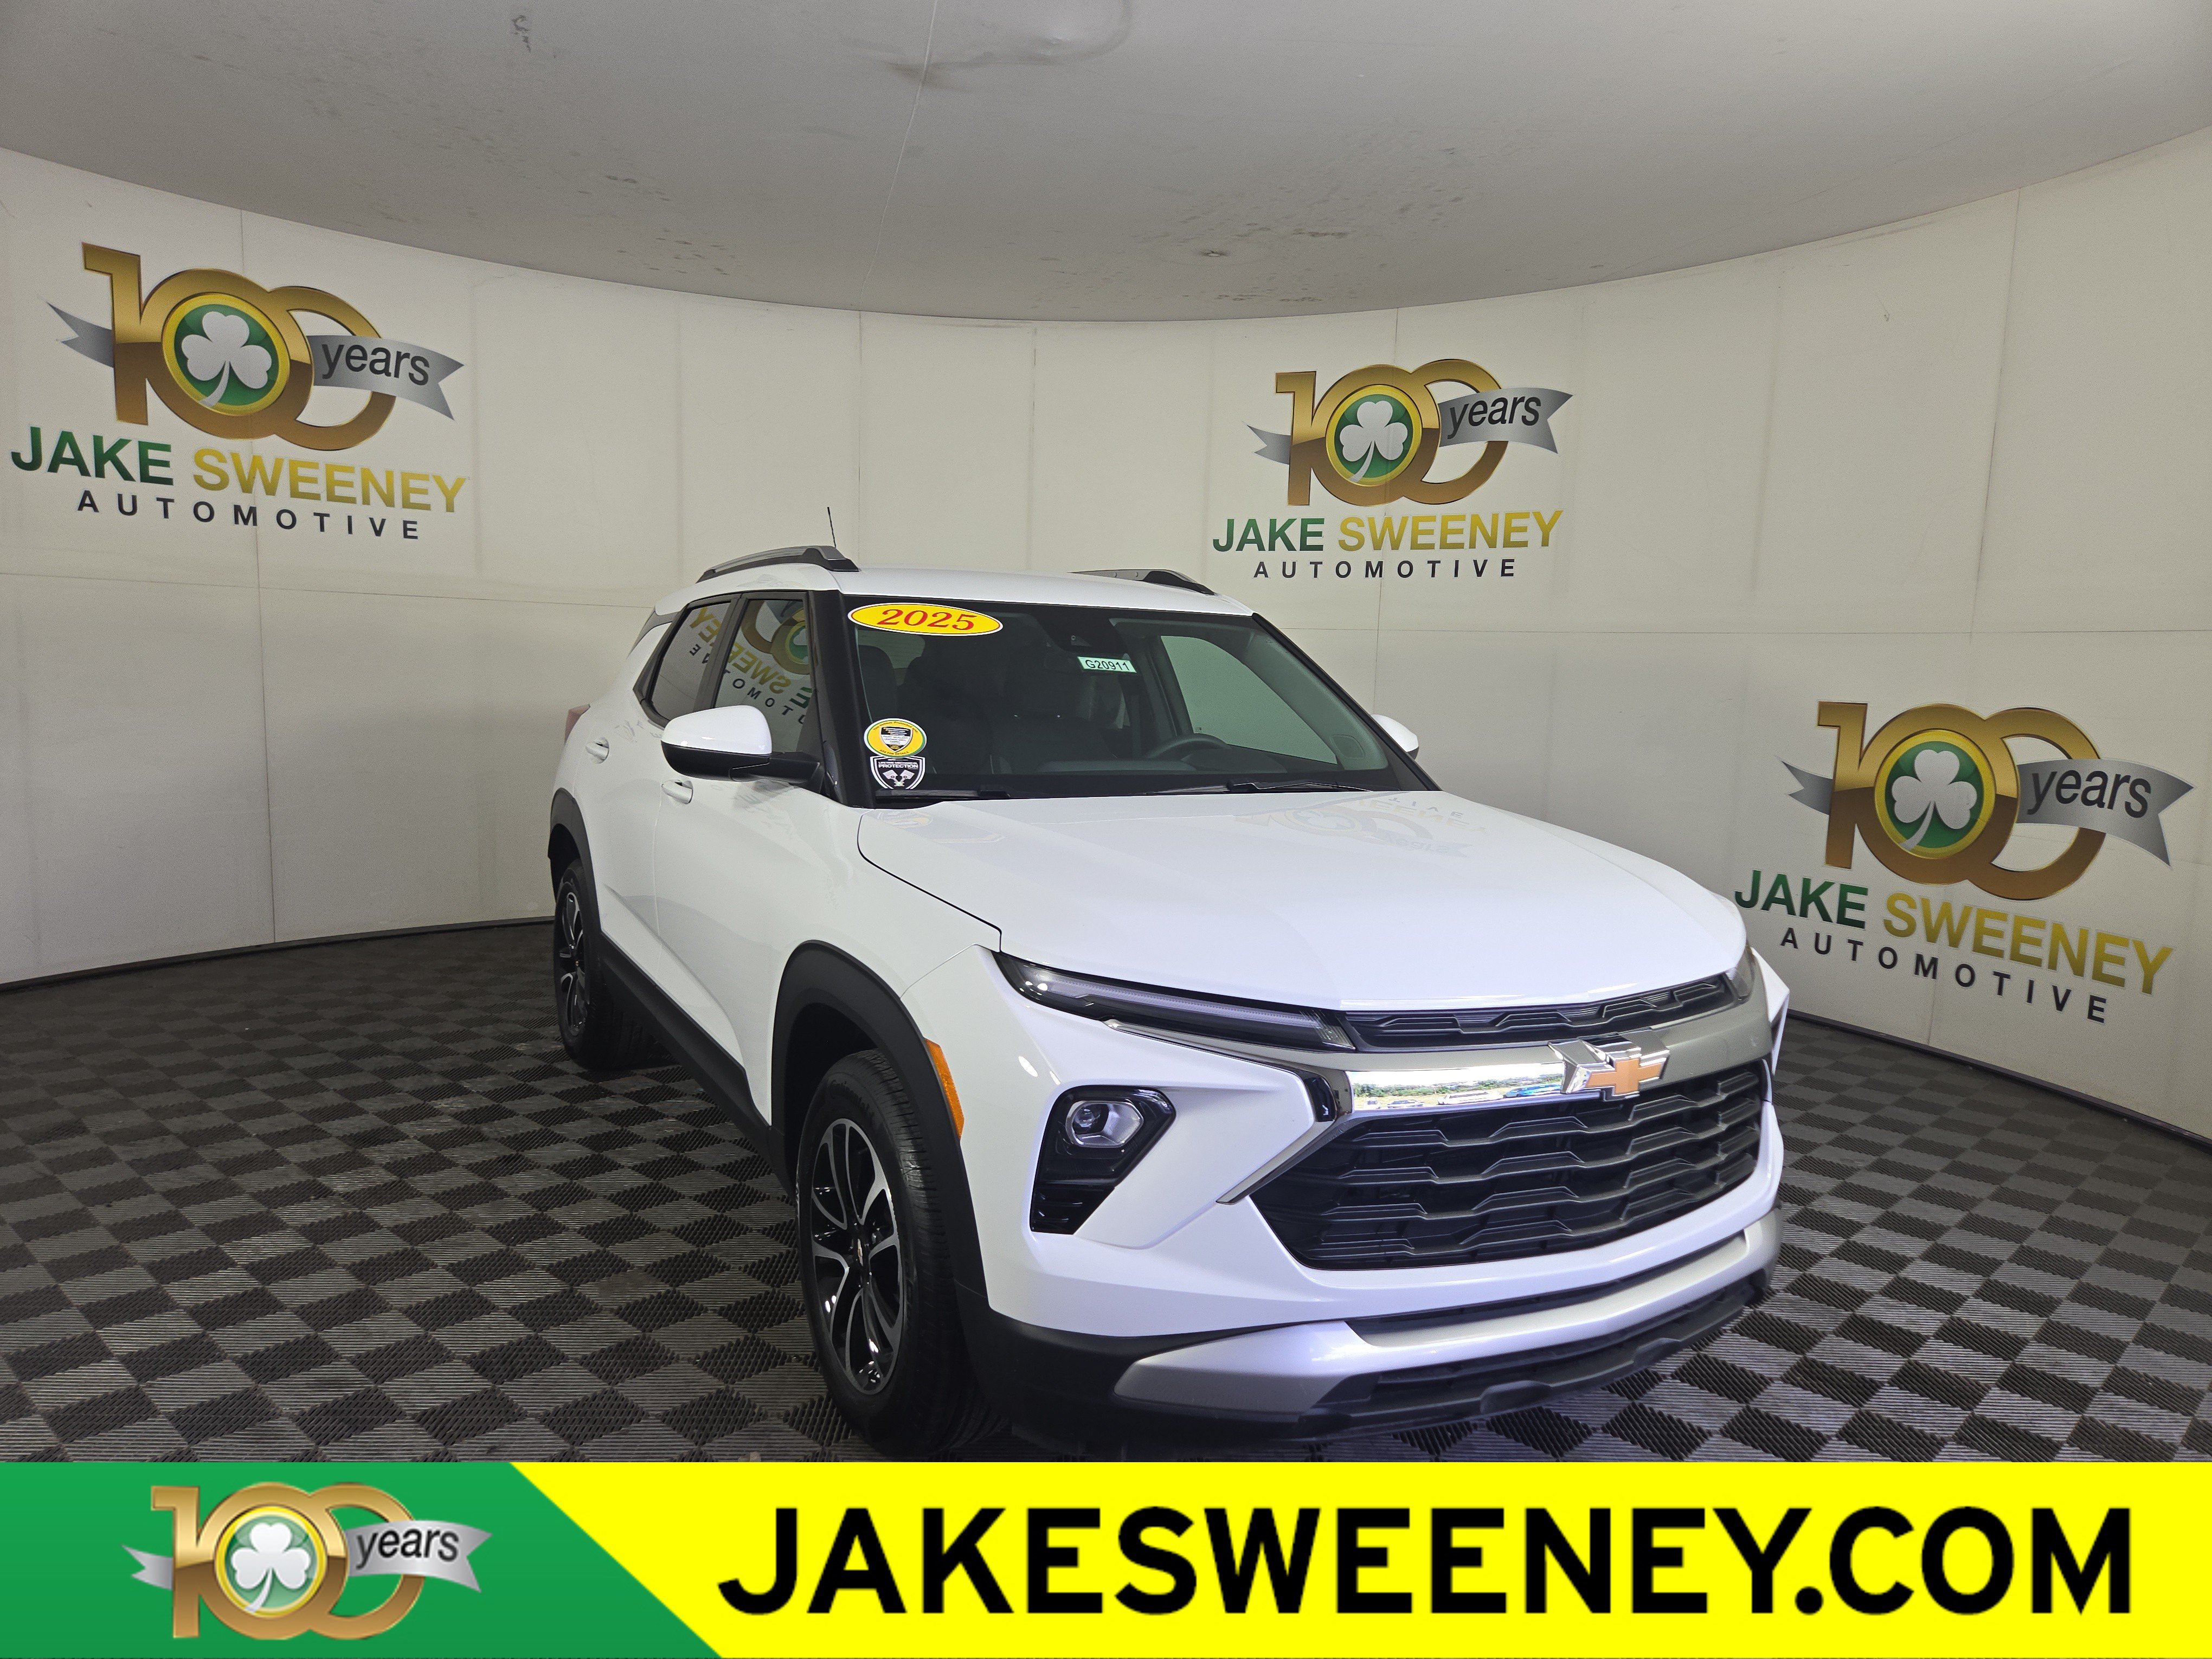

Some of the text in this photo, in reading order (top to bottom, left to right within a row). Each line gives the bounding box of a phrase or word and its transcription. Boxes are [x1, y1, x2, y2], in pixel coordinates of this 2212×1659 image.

[82, 242, 432, 451] 100 years
[11, 426, 468, 513] JAKE SWEENEY
[1275, 358, 1542, 507] 100 years
[78, 490, 419, 540] AUTOMOTIVE
[1212, 510, 1564, 552] JAKE SWEENEY
[1253, 558, 1515, 579] AUTOMOTIVE
[877, 609, 978, 631] 2025
[1085, 659, 1130, 671] G20911
[1817, 700, 2152, 901] 100 years
[1734, 870, 2174, 994] JAKE SWEENEY
[1780, 928, 2107, 1024] AUTOMOTIVE
